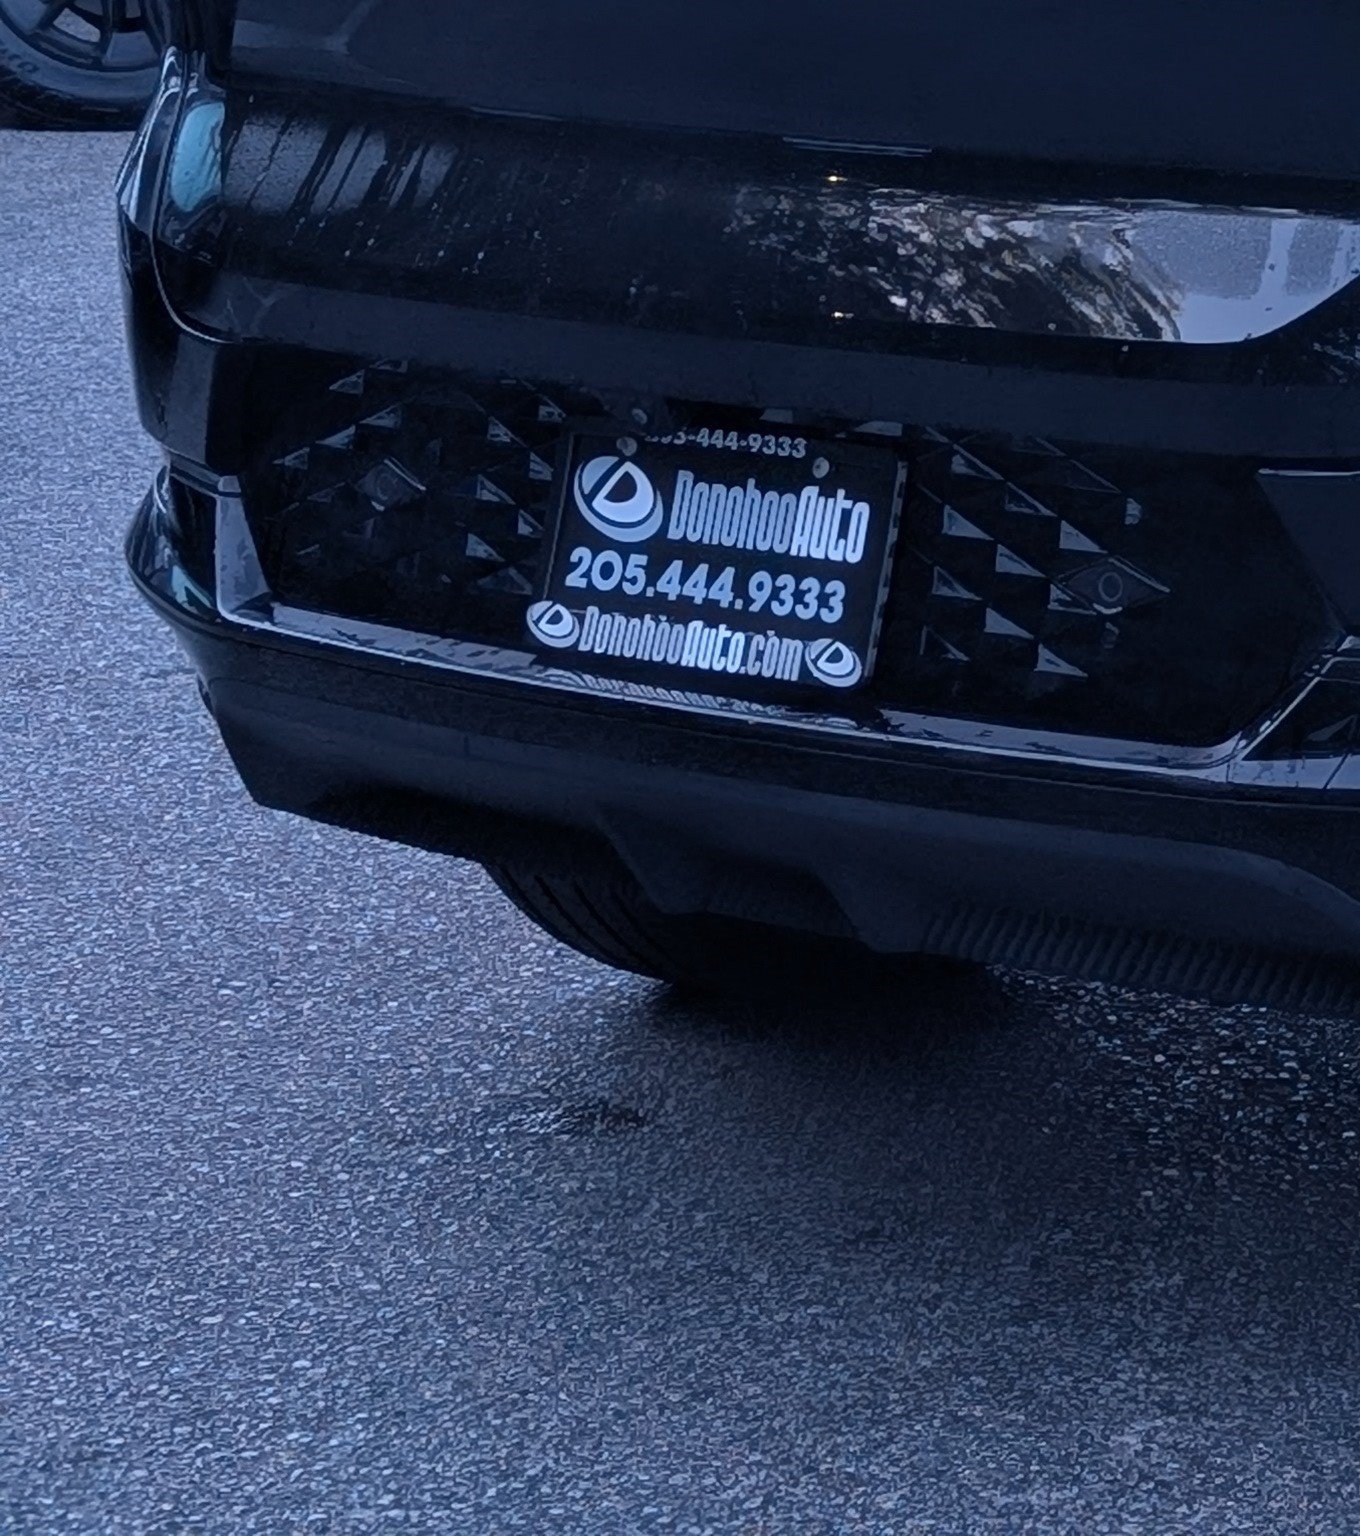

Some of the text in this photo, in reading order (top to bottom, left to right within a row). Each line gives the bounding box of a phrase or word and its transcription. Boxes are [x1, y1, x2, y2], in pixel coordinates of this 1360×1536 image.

[667, 469, 871, 564] DonohooAuto
[564, 546, 847, 624] 205.444.9333
[577, 605, 805, 682] DonohooAuto.com
